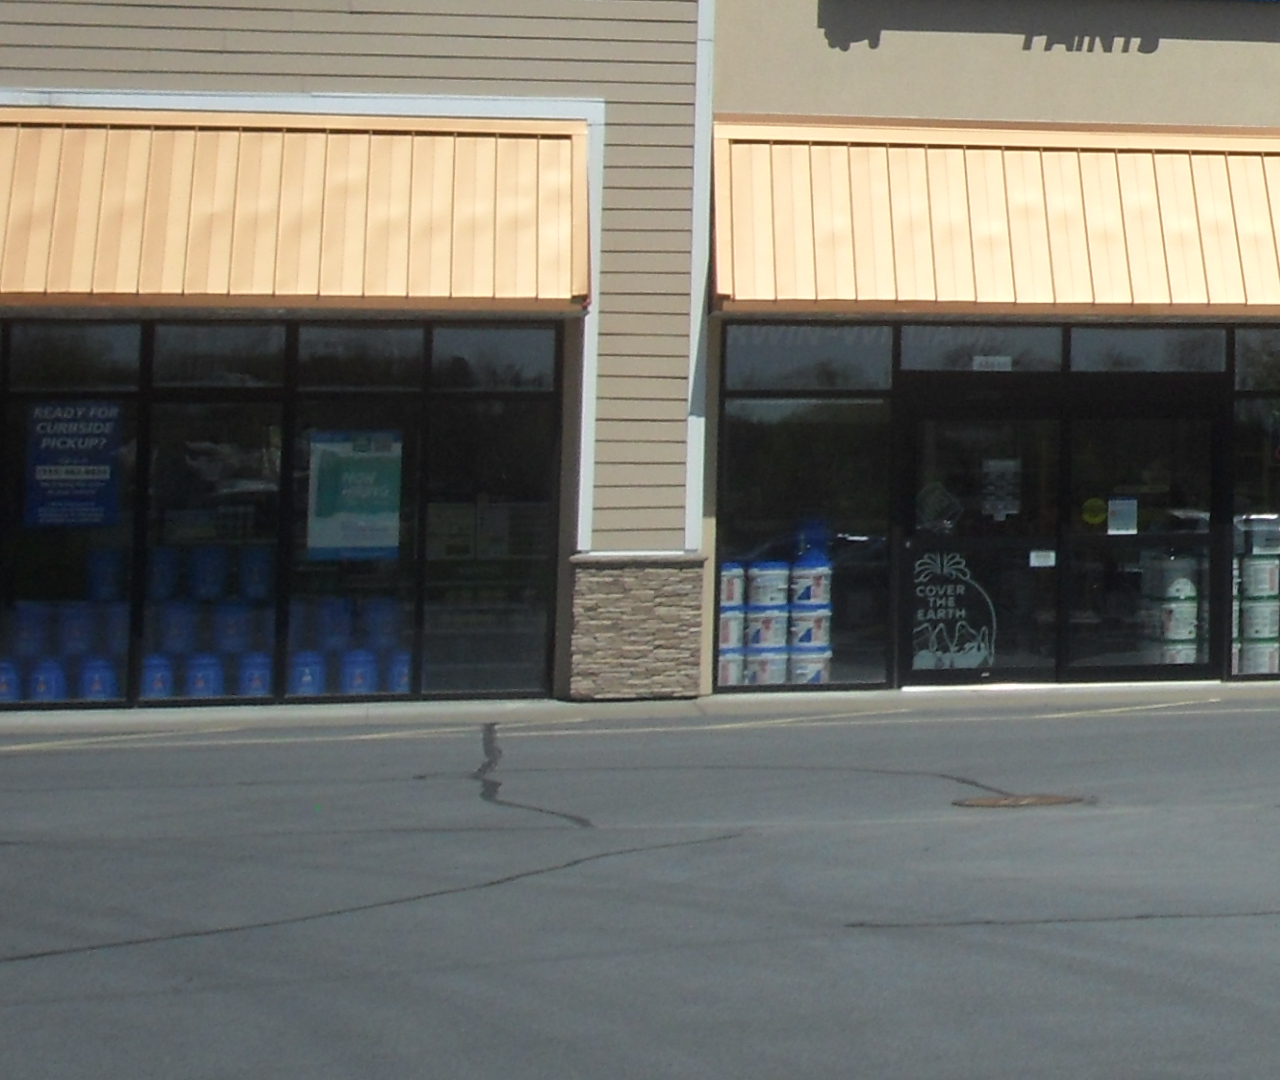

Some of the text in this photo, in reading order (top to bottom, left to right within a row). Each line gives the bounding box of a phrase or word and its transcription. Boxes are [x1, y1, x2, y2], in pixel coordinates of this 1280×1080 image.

[36, 422, 114, 434] CURBSIDE
[40, 437, 107, 449] PICKUP?
[916, 584, 966, 597] COVER
[928, 597, 956, 607] THE
[917, 607, 966, 620] EARTH
